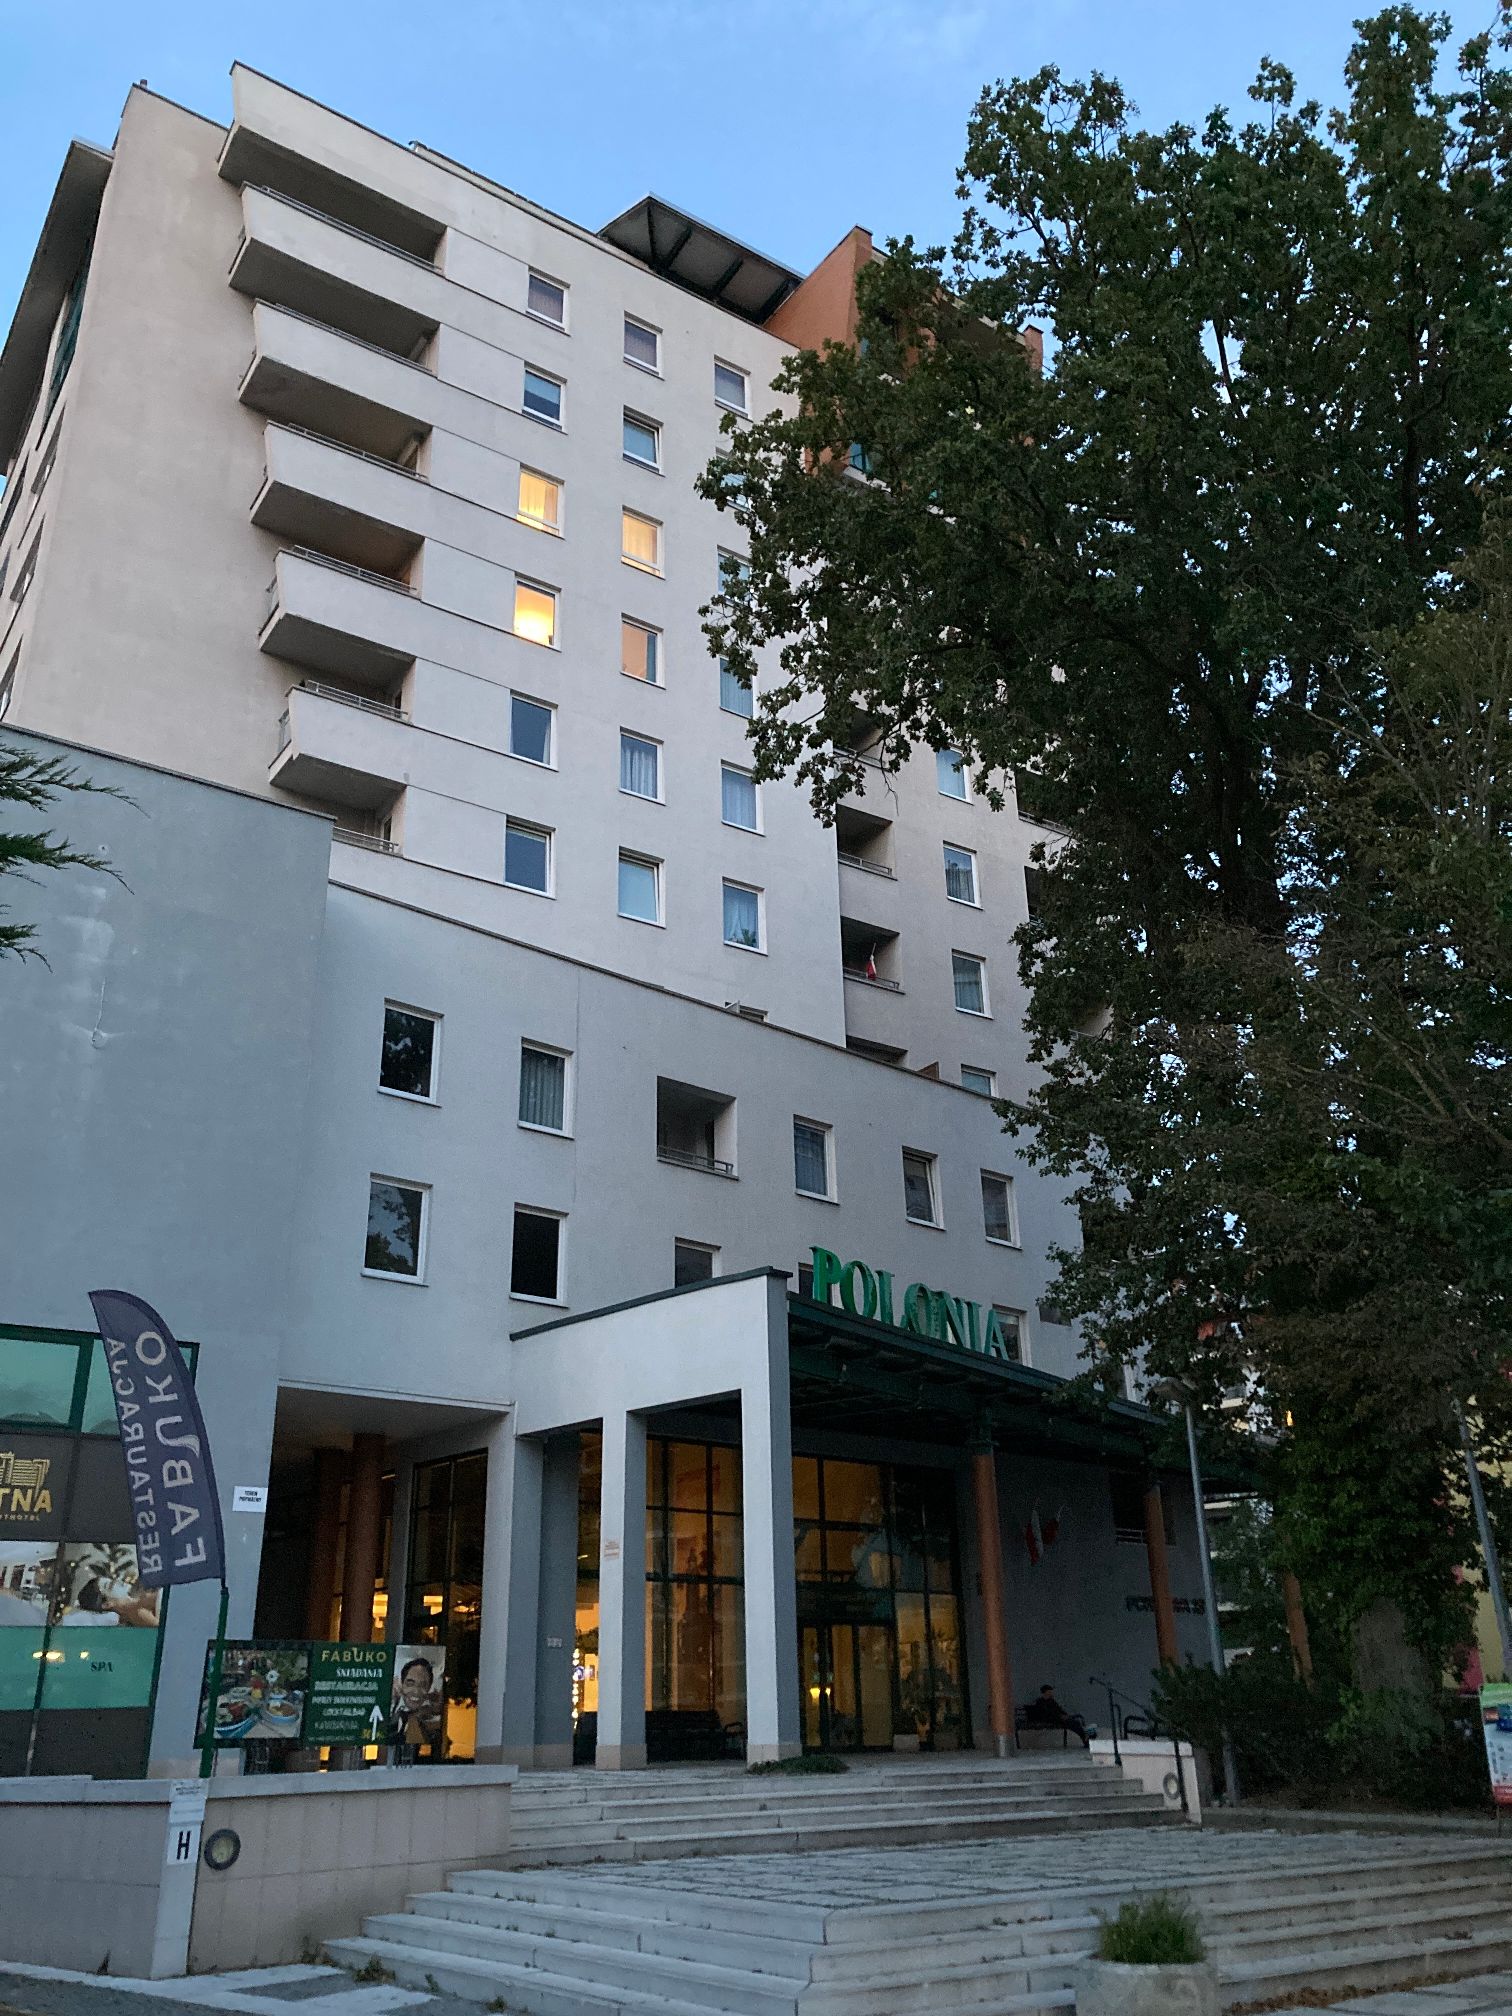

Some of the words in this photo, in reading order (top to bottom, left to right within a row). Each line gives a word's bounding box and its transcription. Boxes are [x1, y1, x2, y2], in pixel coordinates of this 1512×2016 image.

[809, 1246, 1009, 1361] POLONIA
[321, 1646, 387, 1662] FABUKO
[90, 1661, 113, 1672] SPA
[176, 1830, 192, 1860] H
